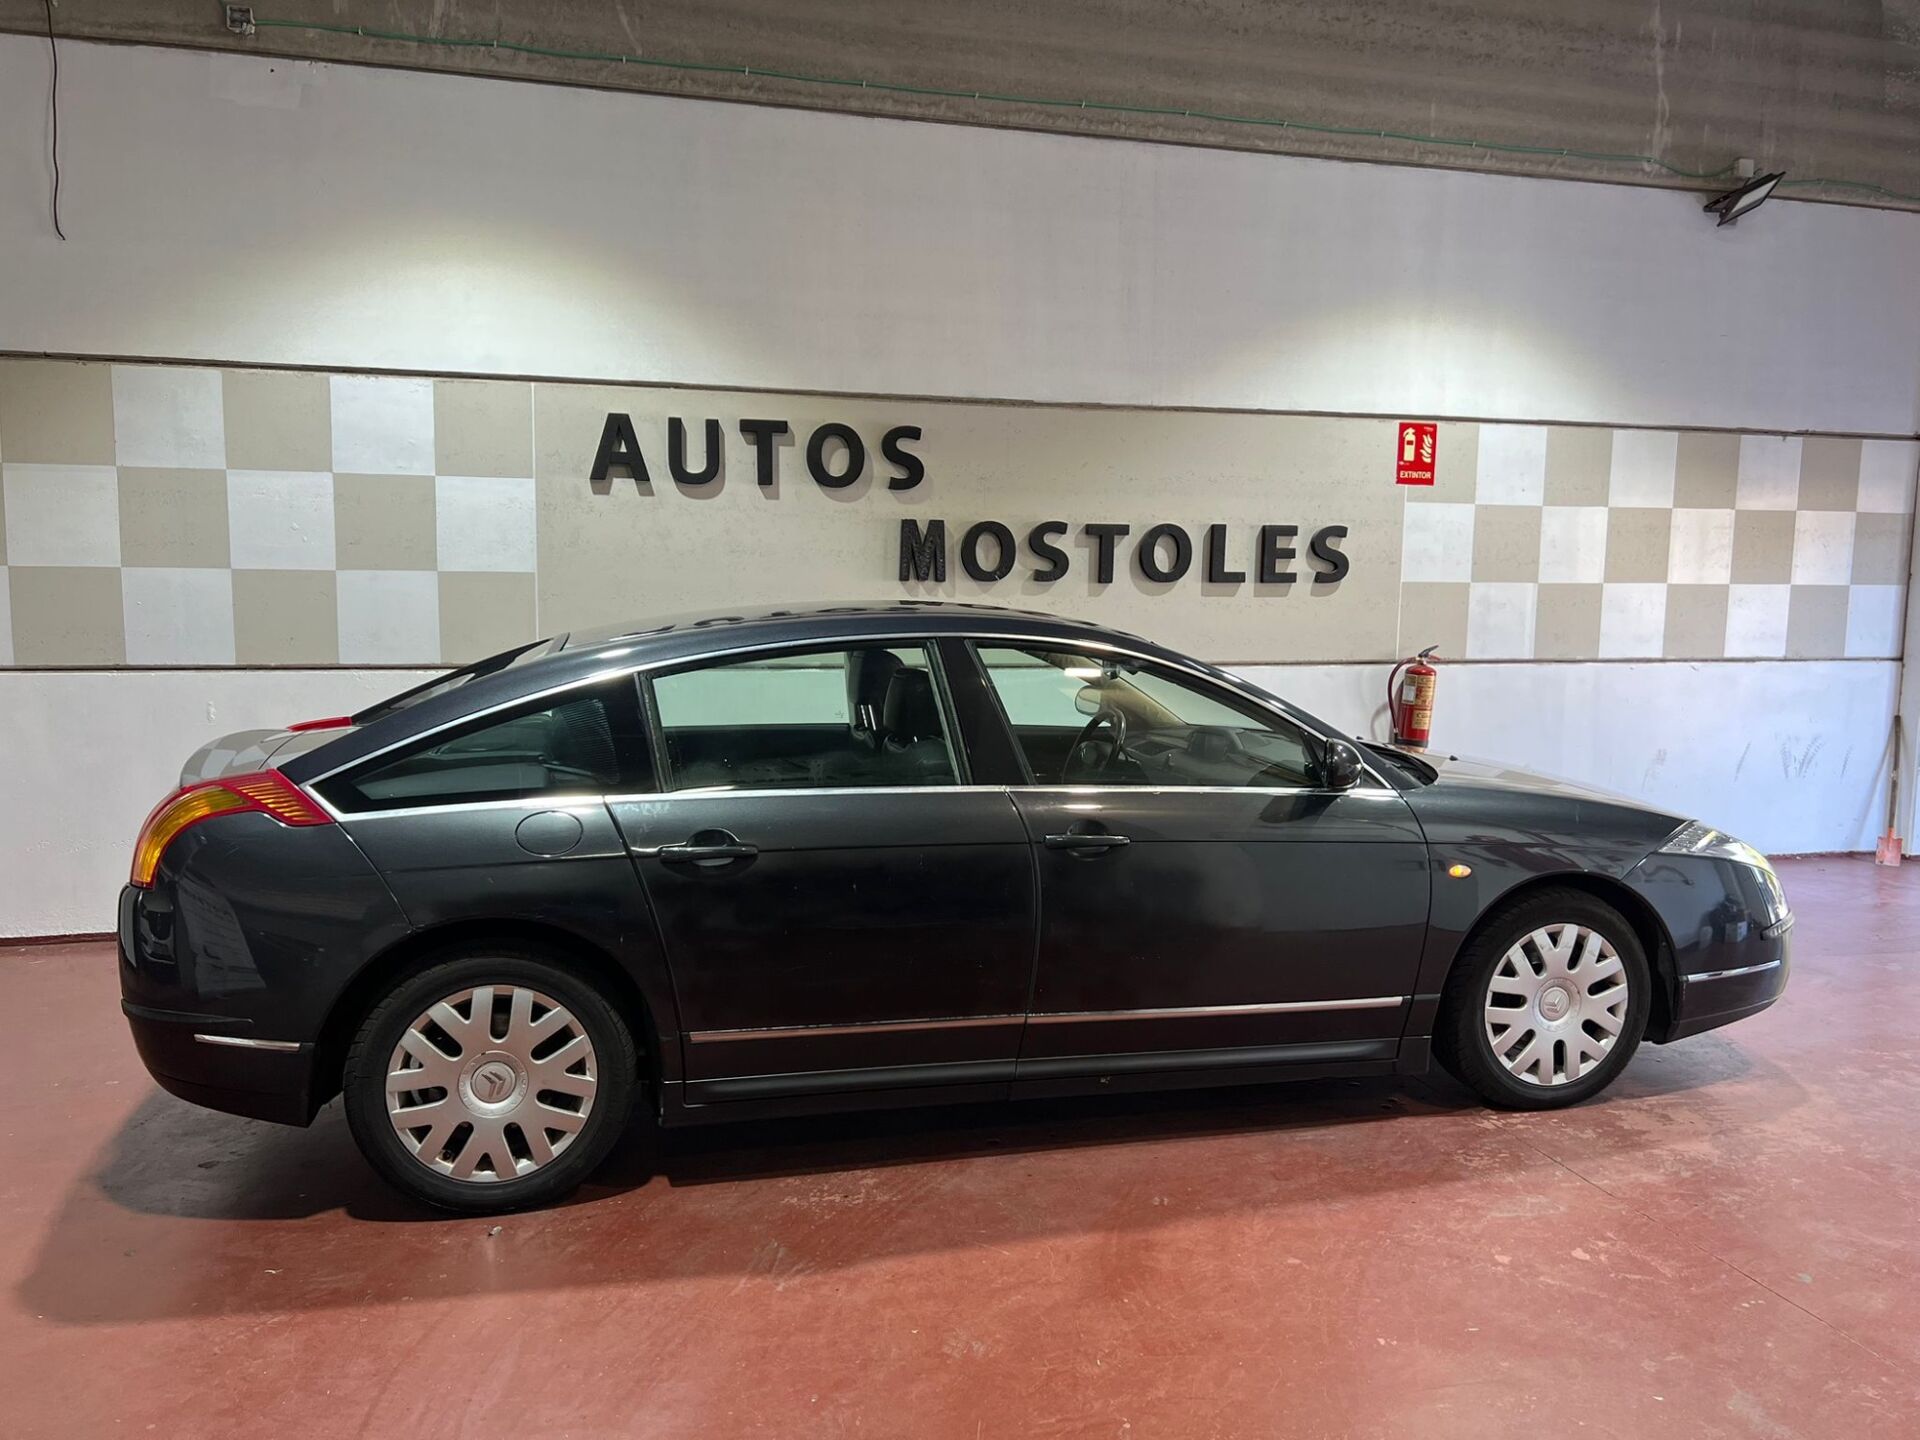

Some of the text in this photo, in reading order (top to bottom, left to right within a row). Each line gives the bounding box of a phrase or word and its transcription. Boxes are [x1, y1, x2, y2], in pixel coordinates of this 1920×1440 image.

[590, 412, 925, 491] AUTOS
[1400, 470, 1432, 479] EXTINTOR
[899, 518, 1350, 584] MOSTOLES
